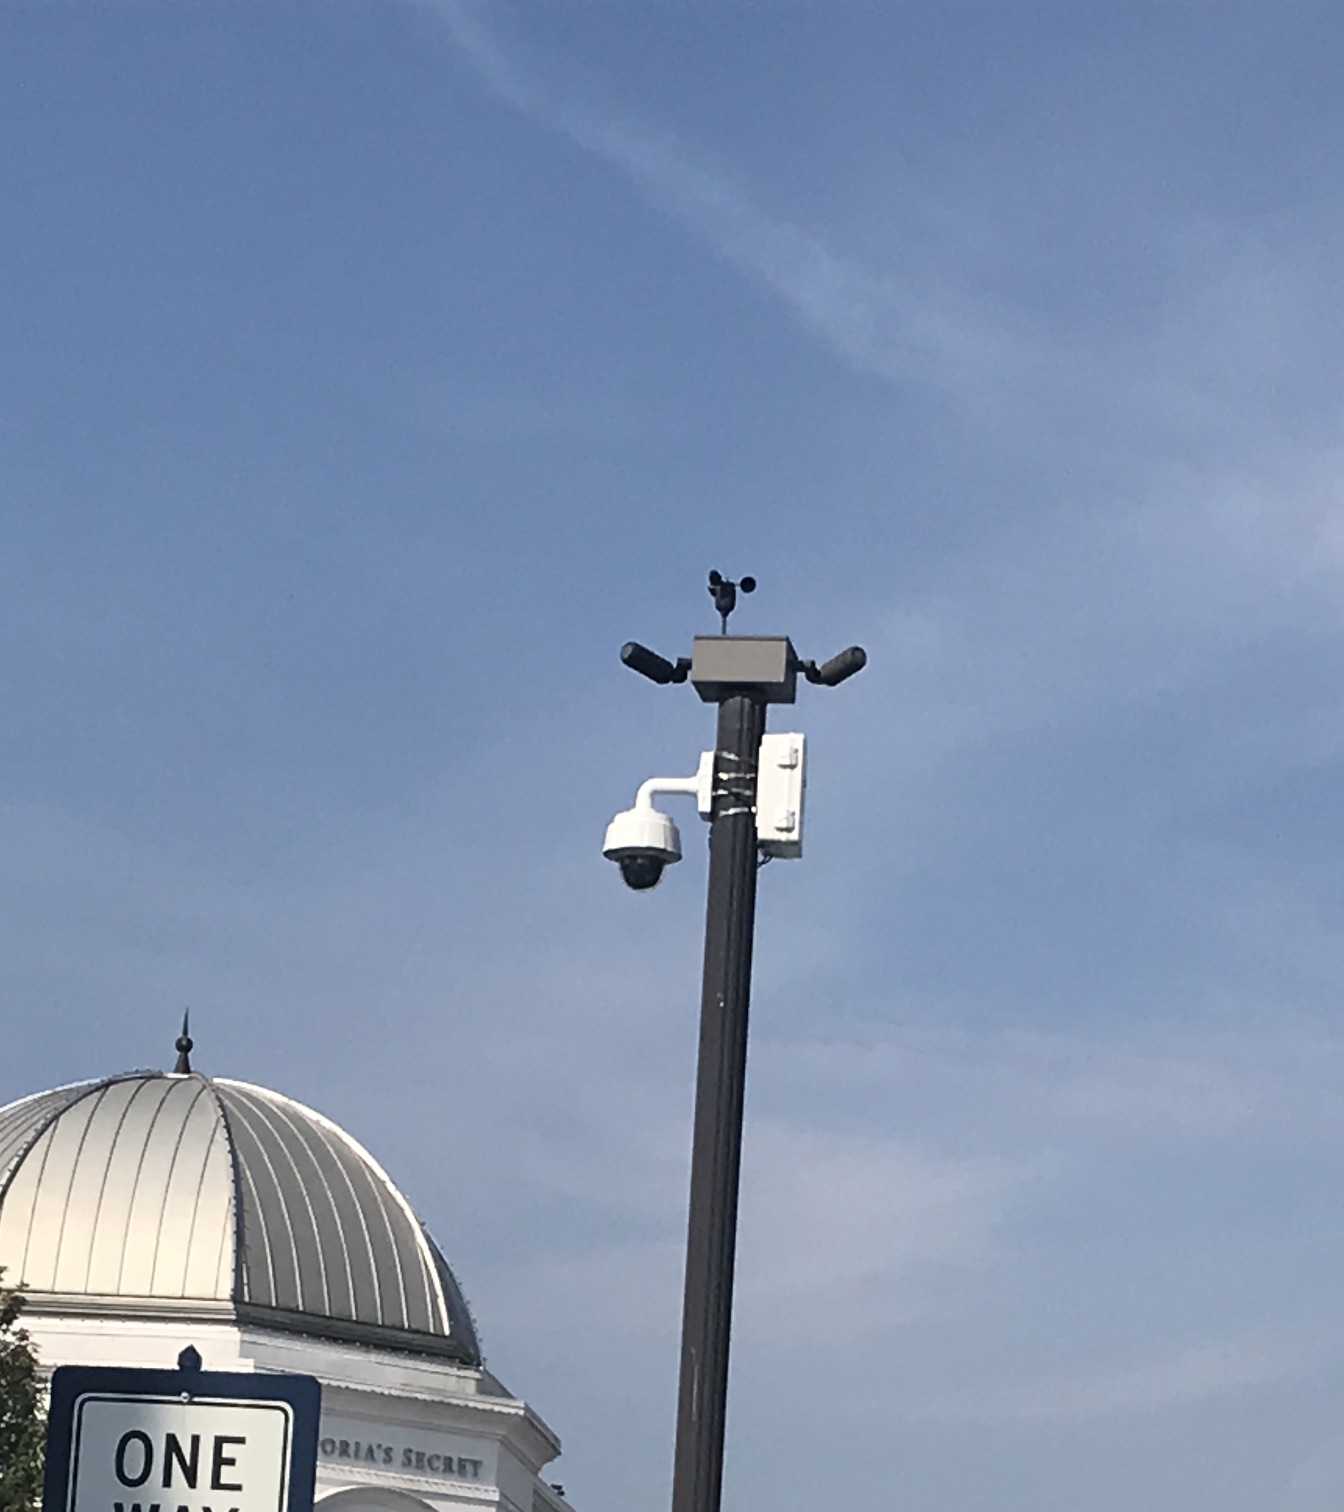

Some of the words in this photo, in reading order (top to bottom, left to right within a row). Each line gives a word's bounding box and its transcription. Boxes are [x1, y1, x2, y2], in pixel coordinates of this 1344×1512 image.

[115, 1429, 247, 1492] ONE
[320, 1437, 394, 1465] ORIA'S
[401, 1447, 484, 1478] SECRET
